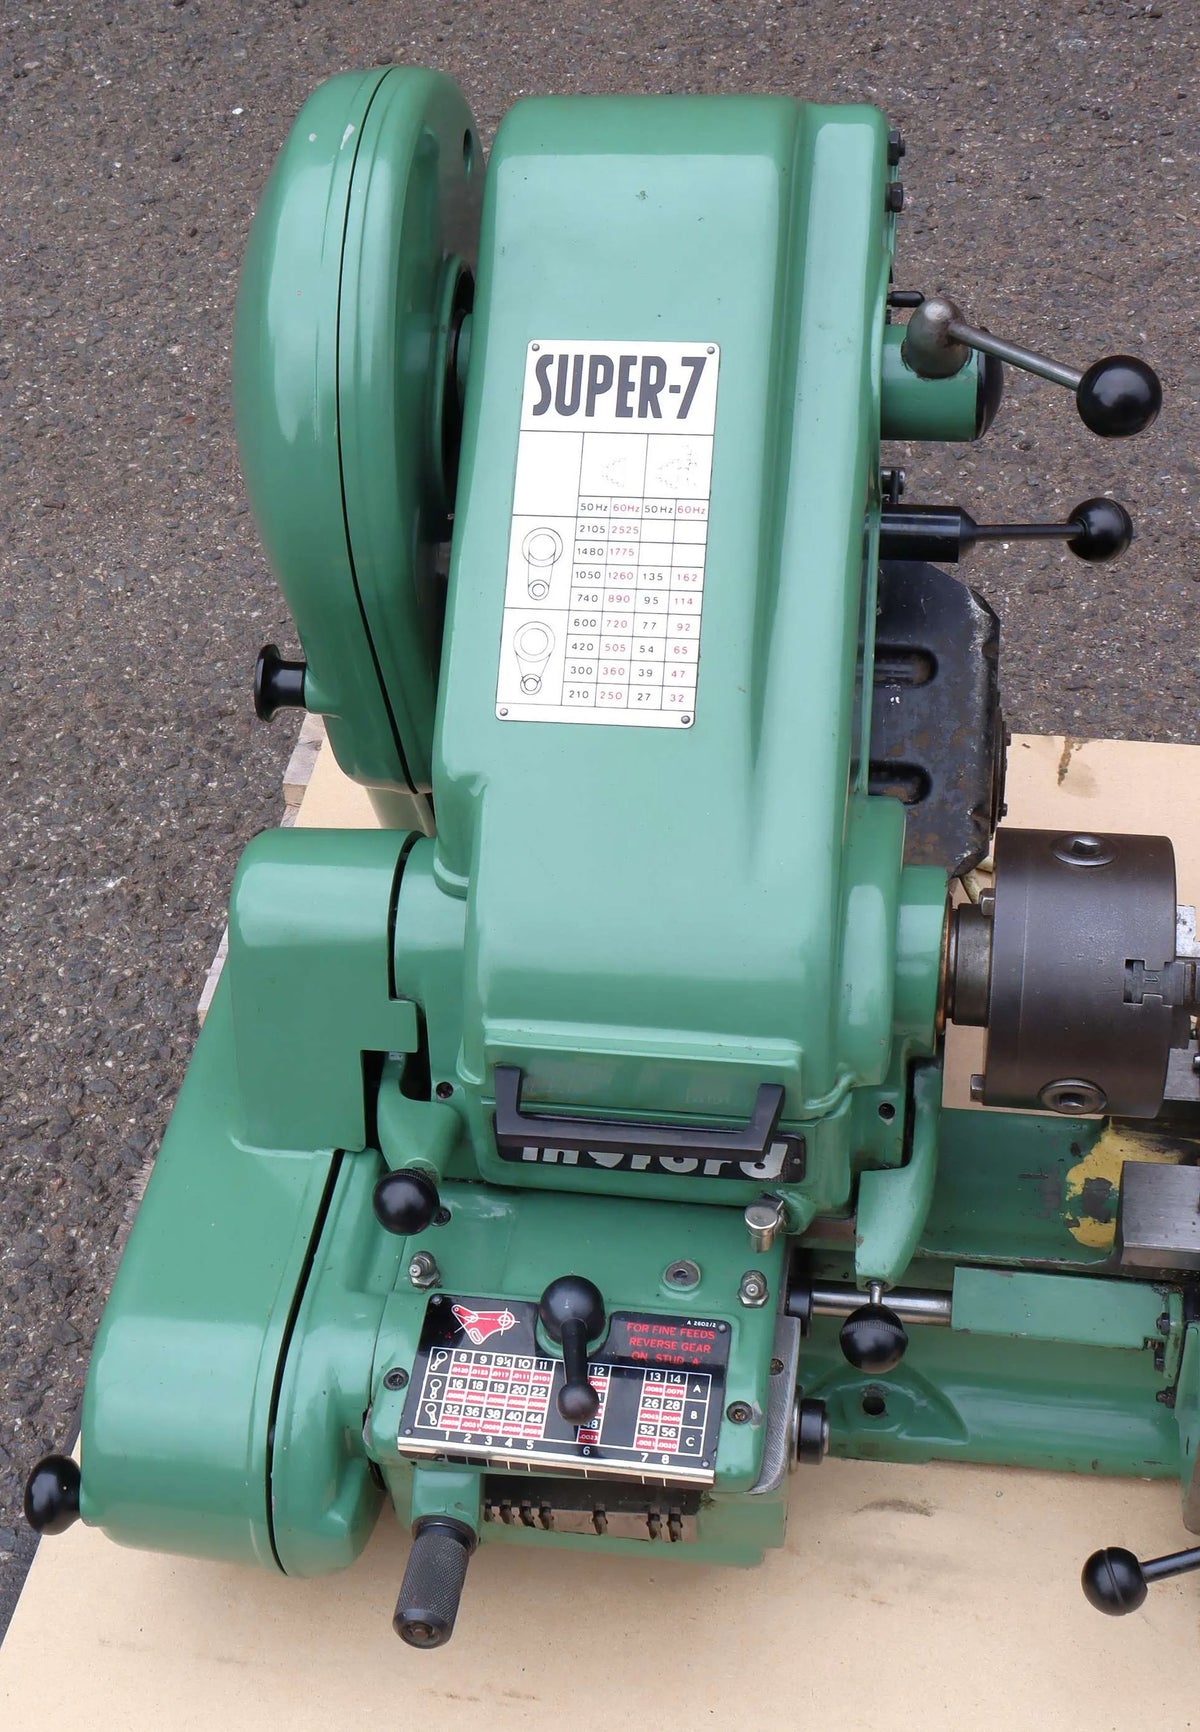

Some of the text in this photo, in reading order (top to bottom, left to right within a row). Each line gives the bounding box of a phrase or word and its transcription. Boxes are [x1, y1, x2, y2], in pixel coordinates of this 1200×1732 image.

[532, 354, 707, 419] SUPER-7
[580, 525, 639, 534] 2105 2525
[578, 548, 604, 556] 1480
[575, 571, 698, 582] 1050 1260 135 162
[578, 594, 598, 602] 740
[608, 595, 630, 603] 890
[644, 597, 658, 605] 95
[574, 619, 691, 631] 600 720 77 92
[572, 643, 594, 651] 420
[604, 644, 626, 652] 505
[674, 646, 688, 654] 65
[570, 666, 686, 678] 300 360 39 47
[600, 691, 622, 700] 250
[638, 693, 651, 701] 27
[670, 694, 684, 702] 32
[626, 1322, 716, 1340] FOR FINE FEEDS
[629, 1337, 711, 1353] REVERSE GEAR
[631, 1351, 648, 1361] ON
[656, 1354, 684, 1364] STUD
[459, 1354, 466, 1362] 8
[480, 1356, 487, 1364] 9
[518, 1359, 531, 1368] 10
[539, 1361, 547, 1370] 11
[594, 1367, 605, 1376] 12
[650, 1373, 661, 1381] 13
[670, 1375, 681, 1383] 14
[453, 1379, 681, 1410] 16 18 19 20 22 26 28
[693, 1385, 701, 1393] A
[445, 1405, 460, 1415] 32
[465, 1406, 480, 1416] 36
[487, 1409, 501, 1418] 38
[507, 1411, 521, 1420] 40
[527, 1413, 542, 1423] 44
[640, 1426, 654, 1435] 52
[662, 1428, 676, 1437] 56
[691, 1411, 698, 1419] B
[686, 1437, 695, 1446] C
[445, 1432, 669, 1464] 1 2 3 4 5 6 7 8
